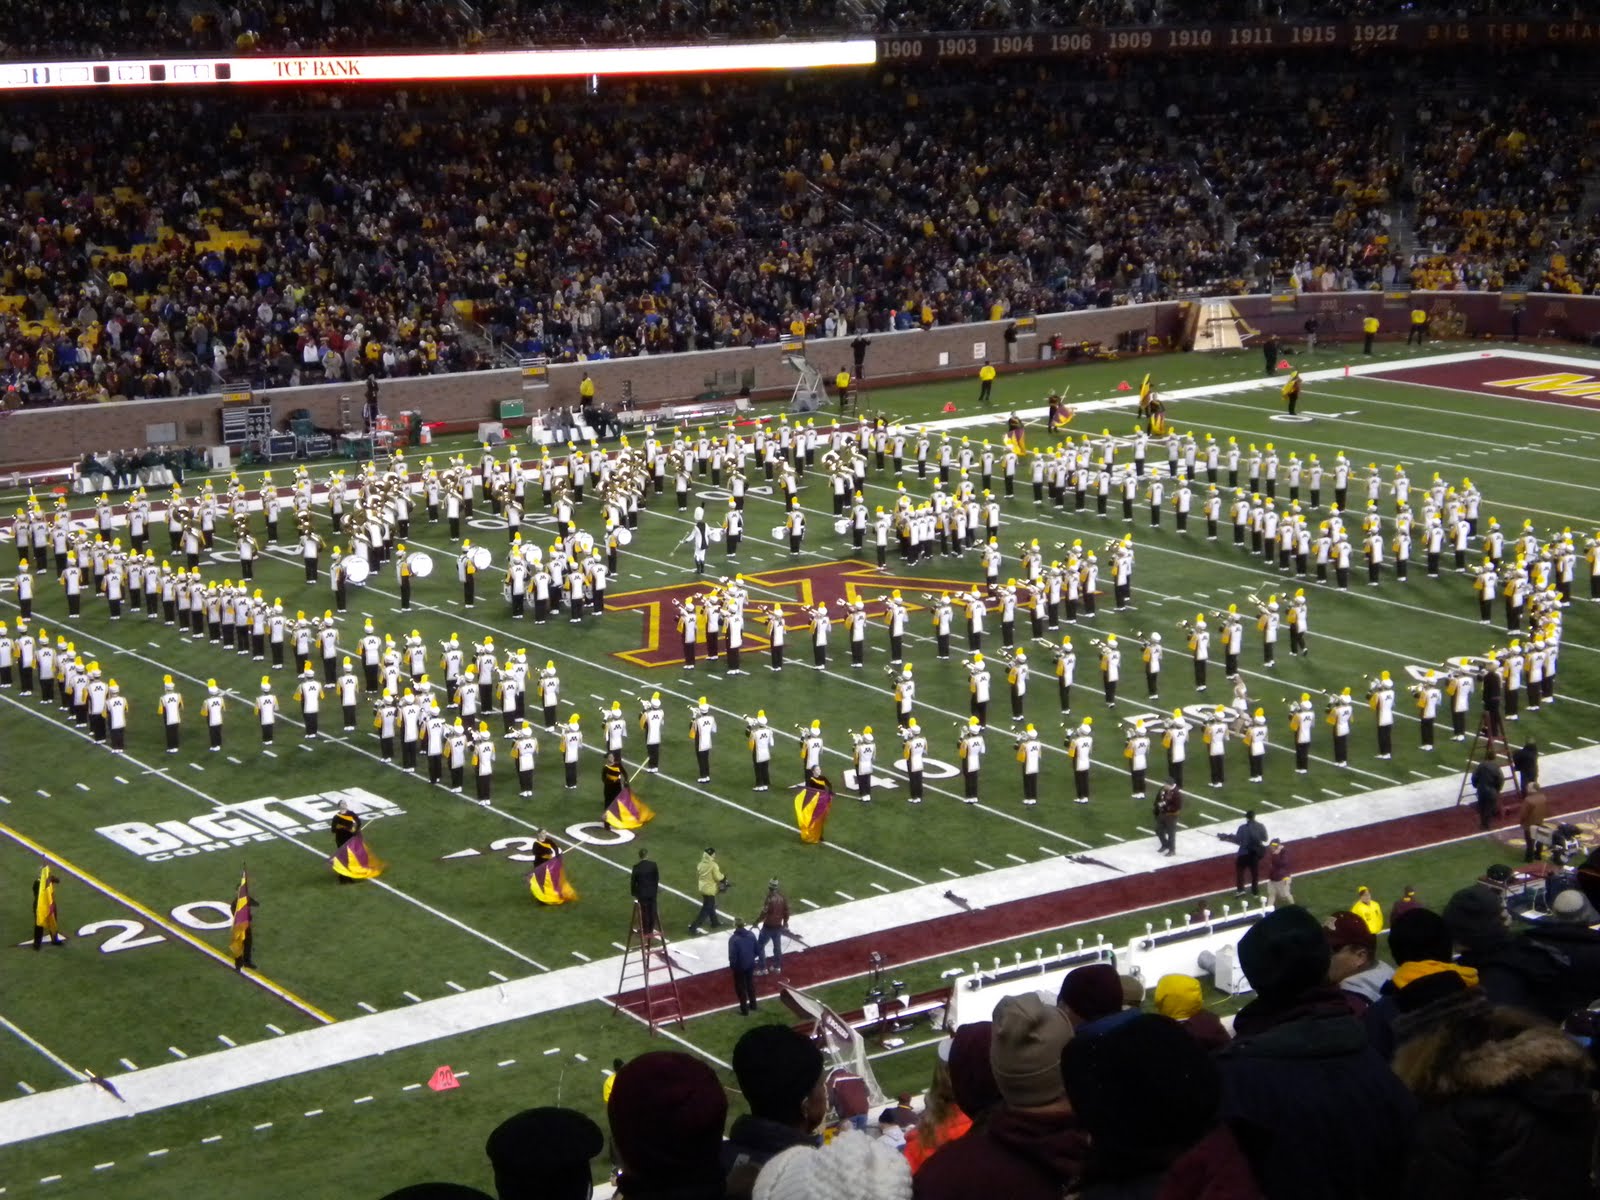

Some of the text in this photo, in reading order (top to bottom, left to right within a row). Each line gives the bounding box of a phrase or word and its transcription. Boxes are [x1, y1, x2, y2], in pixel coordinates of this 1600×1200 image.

[884, 25, 1399, 57] 1900 1903 1904 1906 1909 1910 1911 1915 1927
[1426, 22, 1600, 40] BIG TEN CHA
[272, 60, 360, 77] TCF BANK
[145, 807, 408, 862] CONFERECE
[77, 900, 236, 953] 20
